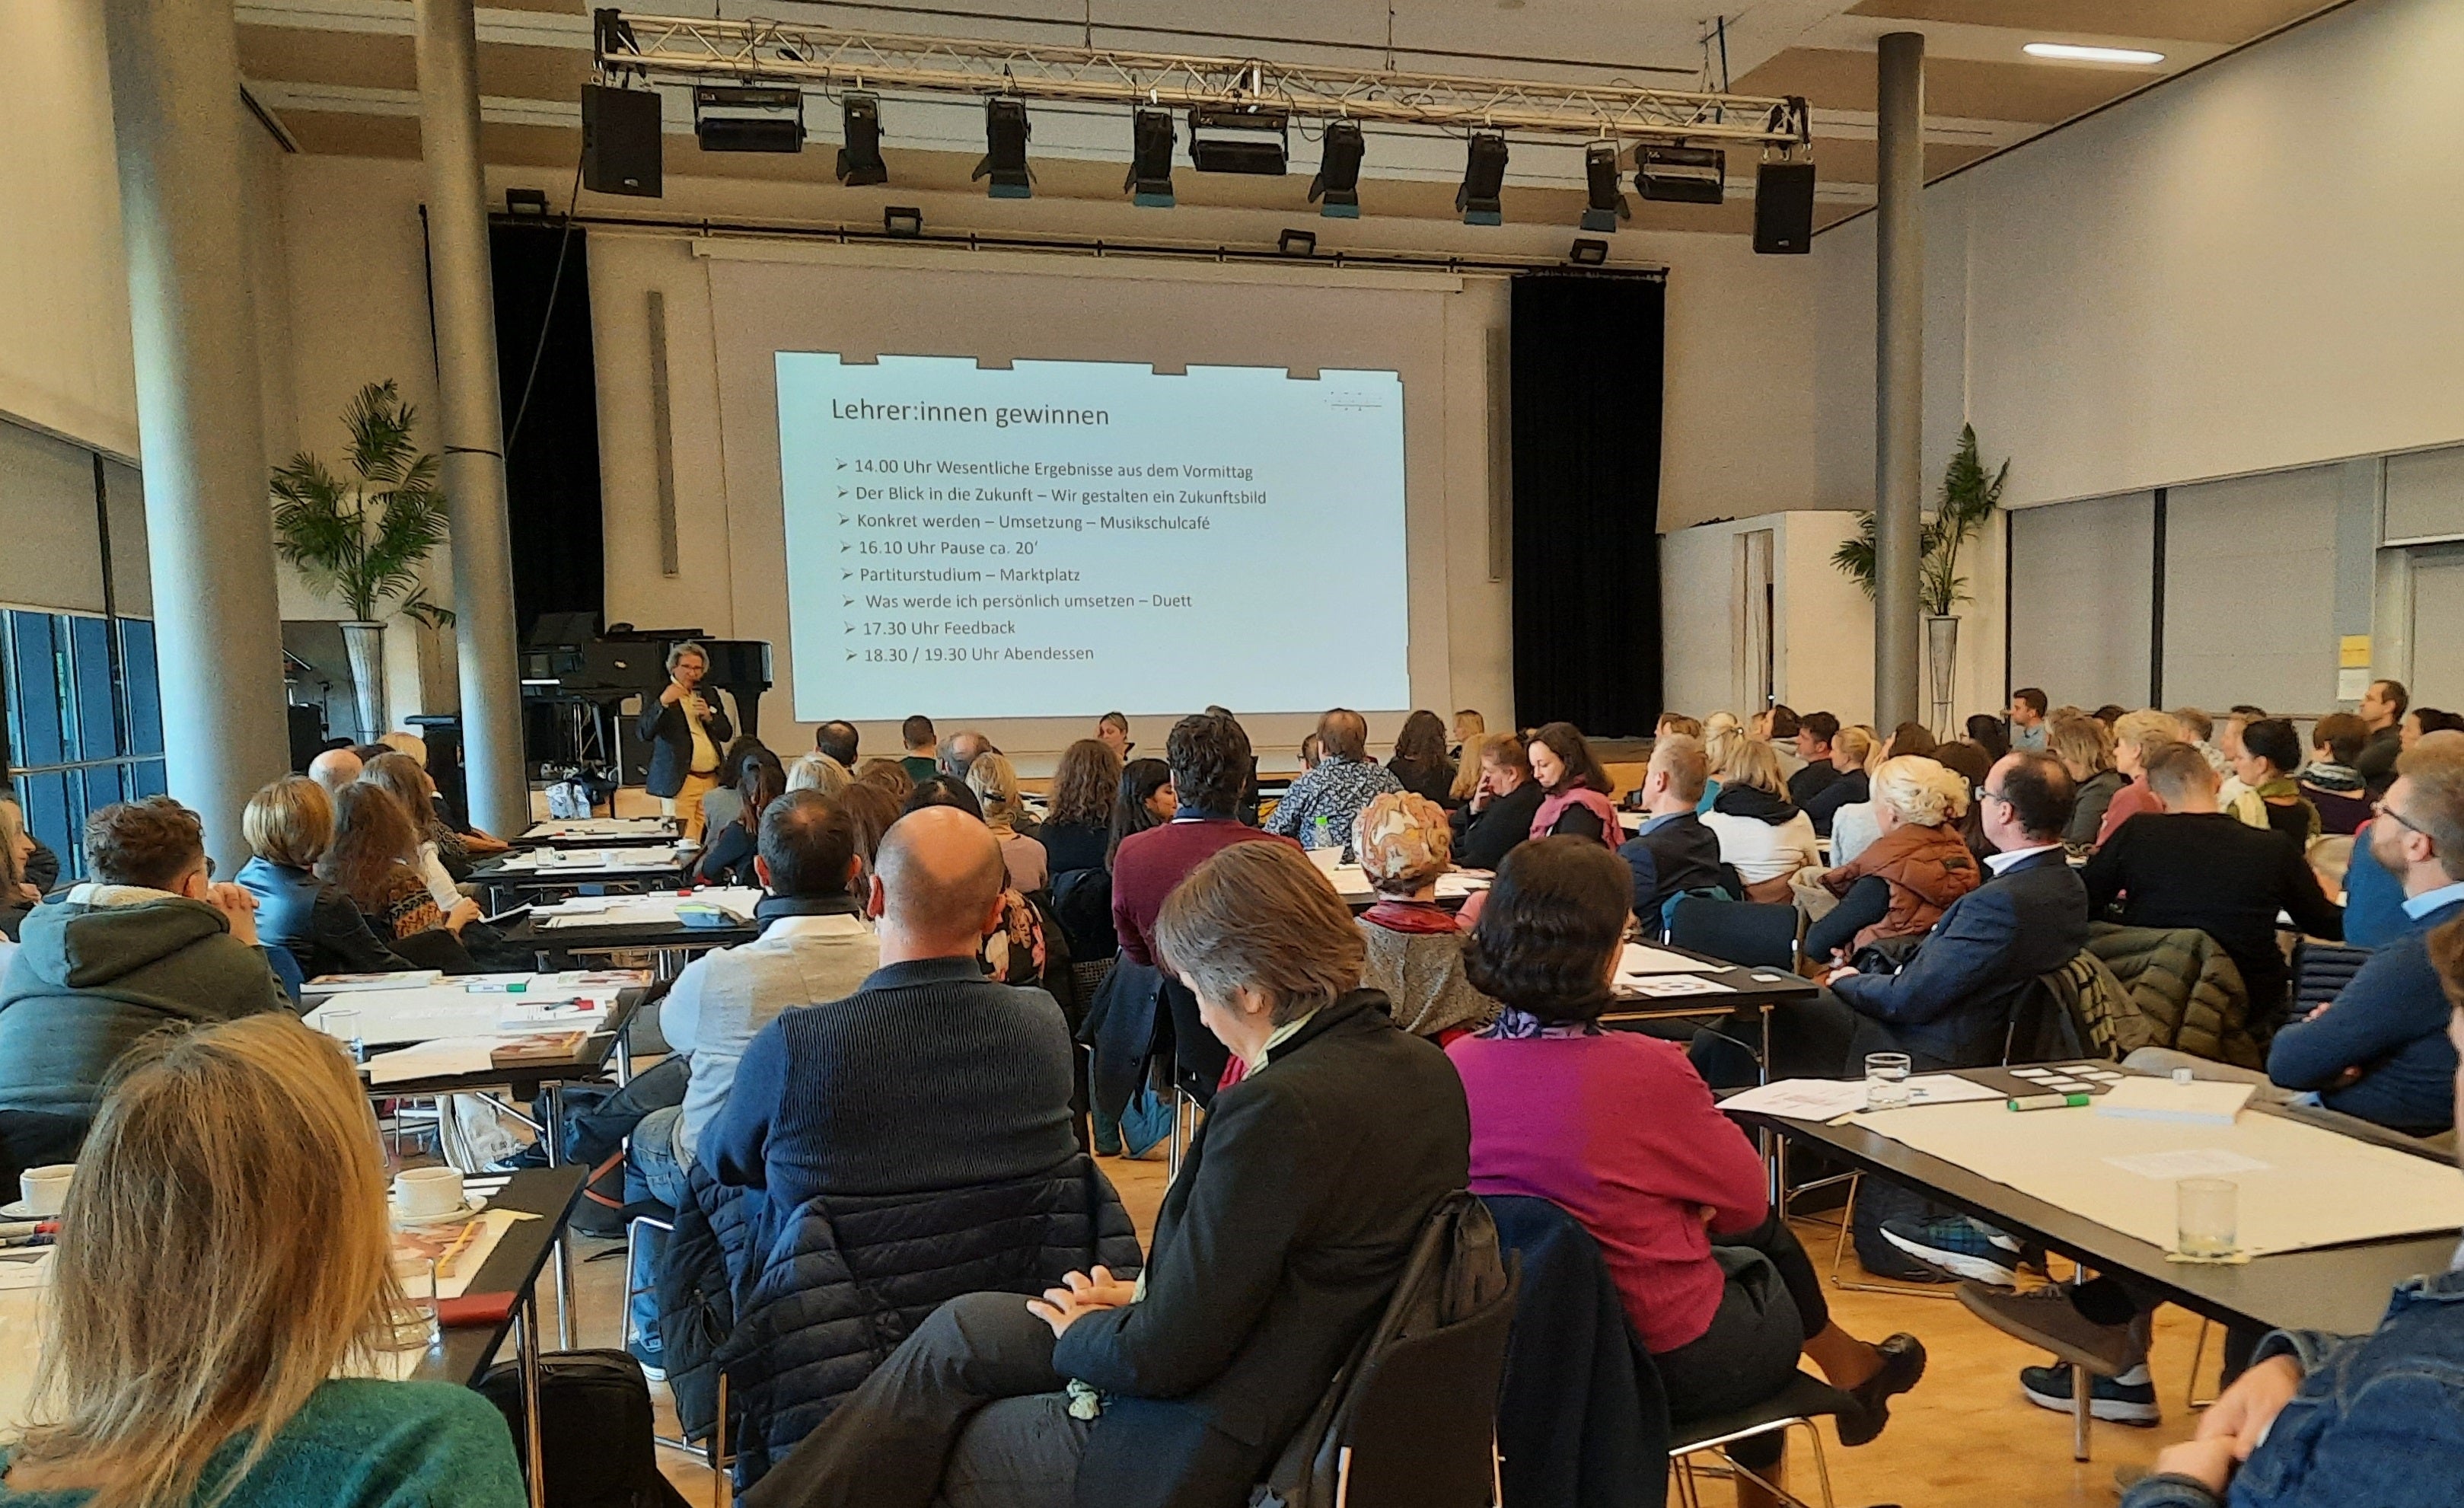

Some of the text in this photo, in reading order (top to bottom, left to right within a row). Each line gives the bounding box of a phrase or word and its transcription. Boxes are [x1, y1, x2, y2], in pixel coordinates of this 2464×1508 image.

[832, 397, 1109, 429] Lehrer:innen gewinnen
[854, 459, 1254, 482] 14.00 Uhr Wesentliche Ergebnisse aus dem Vormittag
[856, 486, 885, 500] Der
[888, 485, 925, 501] Blick
[929, 486, 943, 502] in
[948, 486, 971, 502] die
[974, 486, 1034, 502] Zukunft
[1051, 489, 1078, 502] Wir
[1081, 488, 1149, 506] gestalten
[1152, 489, 1175, 504] ein
[1178, 489, 1267, 505] Zukunftsbild
[857, 513, 918, 528] Konkret
[923, 513, 981, 529] werden
[999, 514, 1082, 532] Umsetzung
[1100, 515, 1211, 530] Musikschulcafé
[859, 540, 903, 555] 16.10
[907, 540, 936, 555] Uhr
[941, 540, 985, 555] Pause
[989, 544, 1010, 555] ca.
[860, 566, 981, 582] Partiturstudium
[999, 567, 1081, 585] Marktplatz
[865, 594, 899, 609] Was
[903, 593, 952, 608] werde
[956, 594, 977, 608] ich
[983, 593, 1060, 611] persönlich
[1064, 595, 1135, 608] umsetzen
[1152, 594, 1193, 607] Duett
[863, 620, 1015, 636] 17.30 Uhr Feedback
[865, 646, 1095, 665] 18.30 / 19.30 Uhr Abendessen
